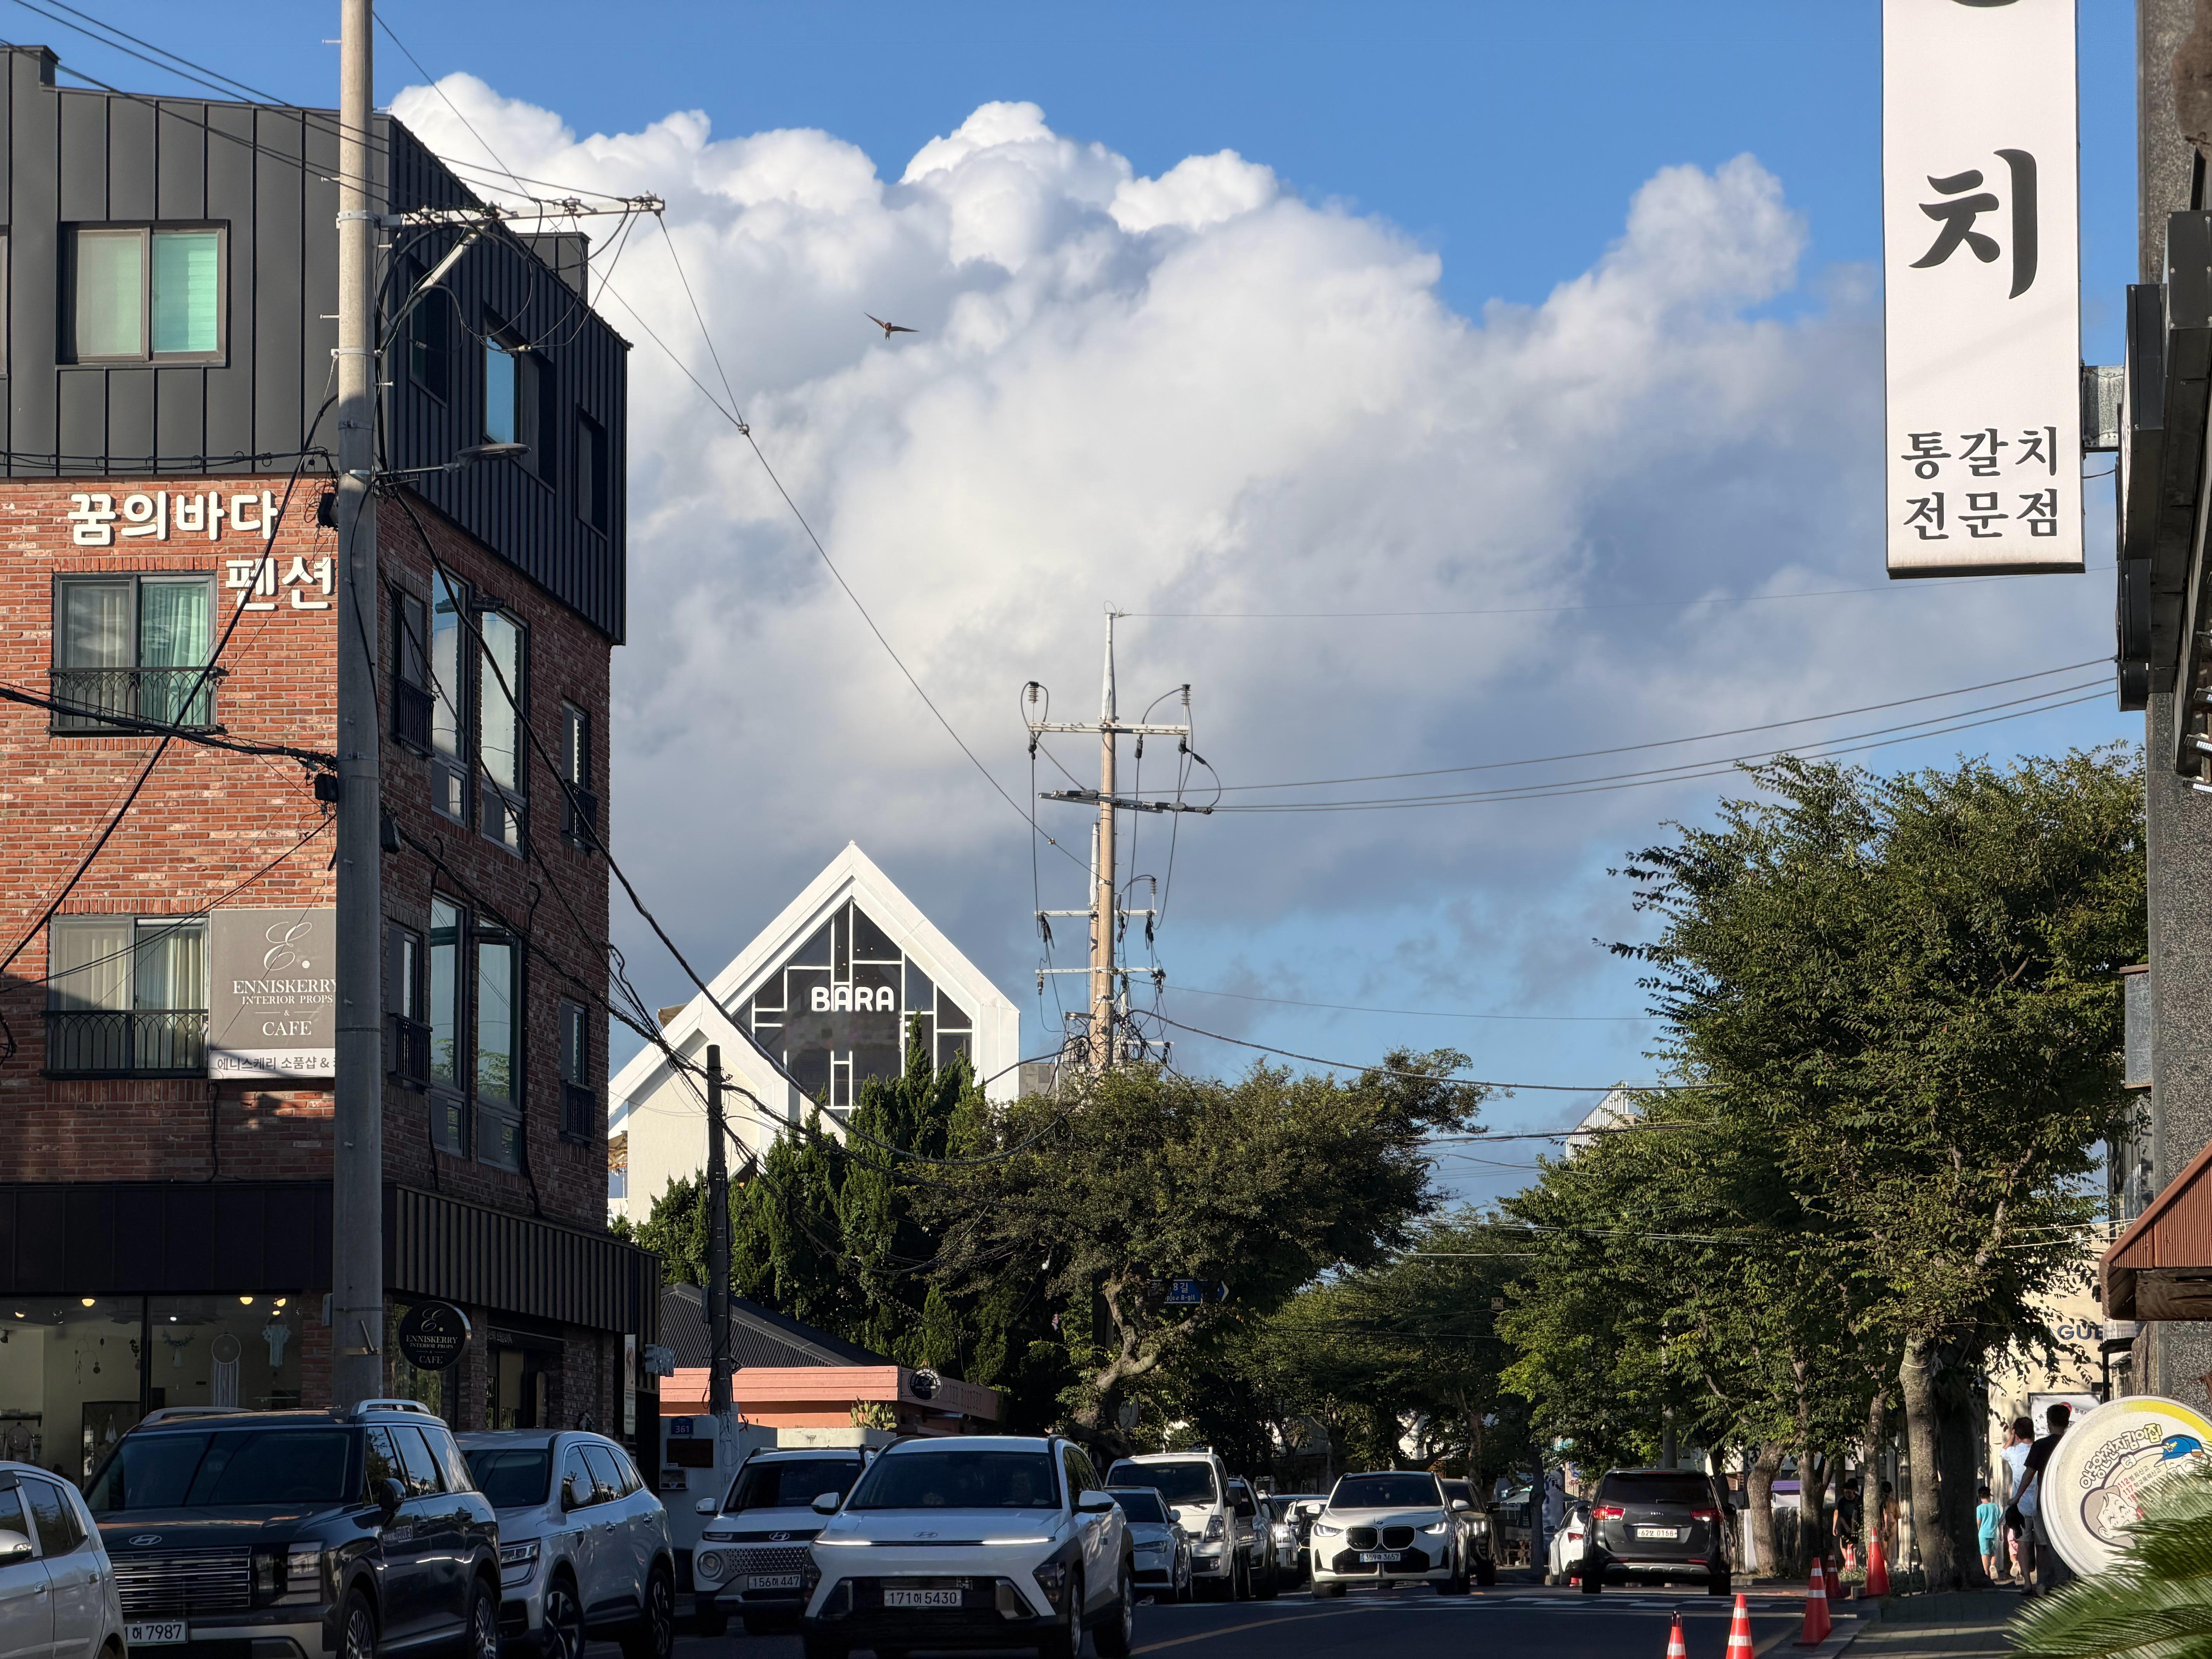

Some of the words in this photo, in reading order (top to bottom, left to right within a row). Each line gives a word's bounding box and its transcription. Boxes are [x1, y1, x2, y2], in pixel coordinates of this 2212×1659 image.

[1901, 426, 2057, 479] 통갈치
[67, 490, 278, 546] 꿈의바다
[1903, 488, 2057, 540] 전문점
[225, 556, 333, 611] 펜션
[242, 995, 295, 1005] INTERIOR
[300, 994, 333, 1004] PROPS
[811, 986, 894, 1012] BARA
[262, 1020, 312, 1036] CAFE
[217, 1057, 276, 1071] 에니스케리
[281, 1056, 317, 1070] 소품샵
[320, 1057, 329, 1068] &
[406, 1334, 458, 1344] ENNISKERRY
[675, 1425, 689, 1433] 361
[2080, 1422, 2163, 1489] 아동안전지킴이집
[2118, 1478, 2130, 1488] 112
[2123, 1485, 2133, 1495] 117
[925, 1592, 957, 1604] 5430
[146, 1625, 182, 1640] 7987
